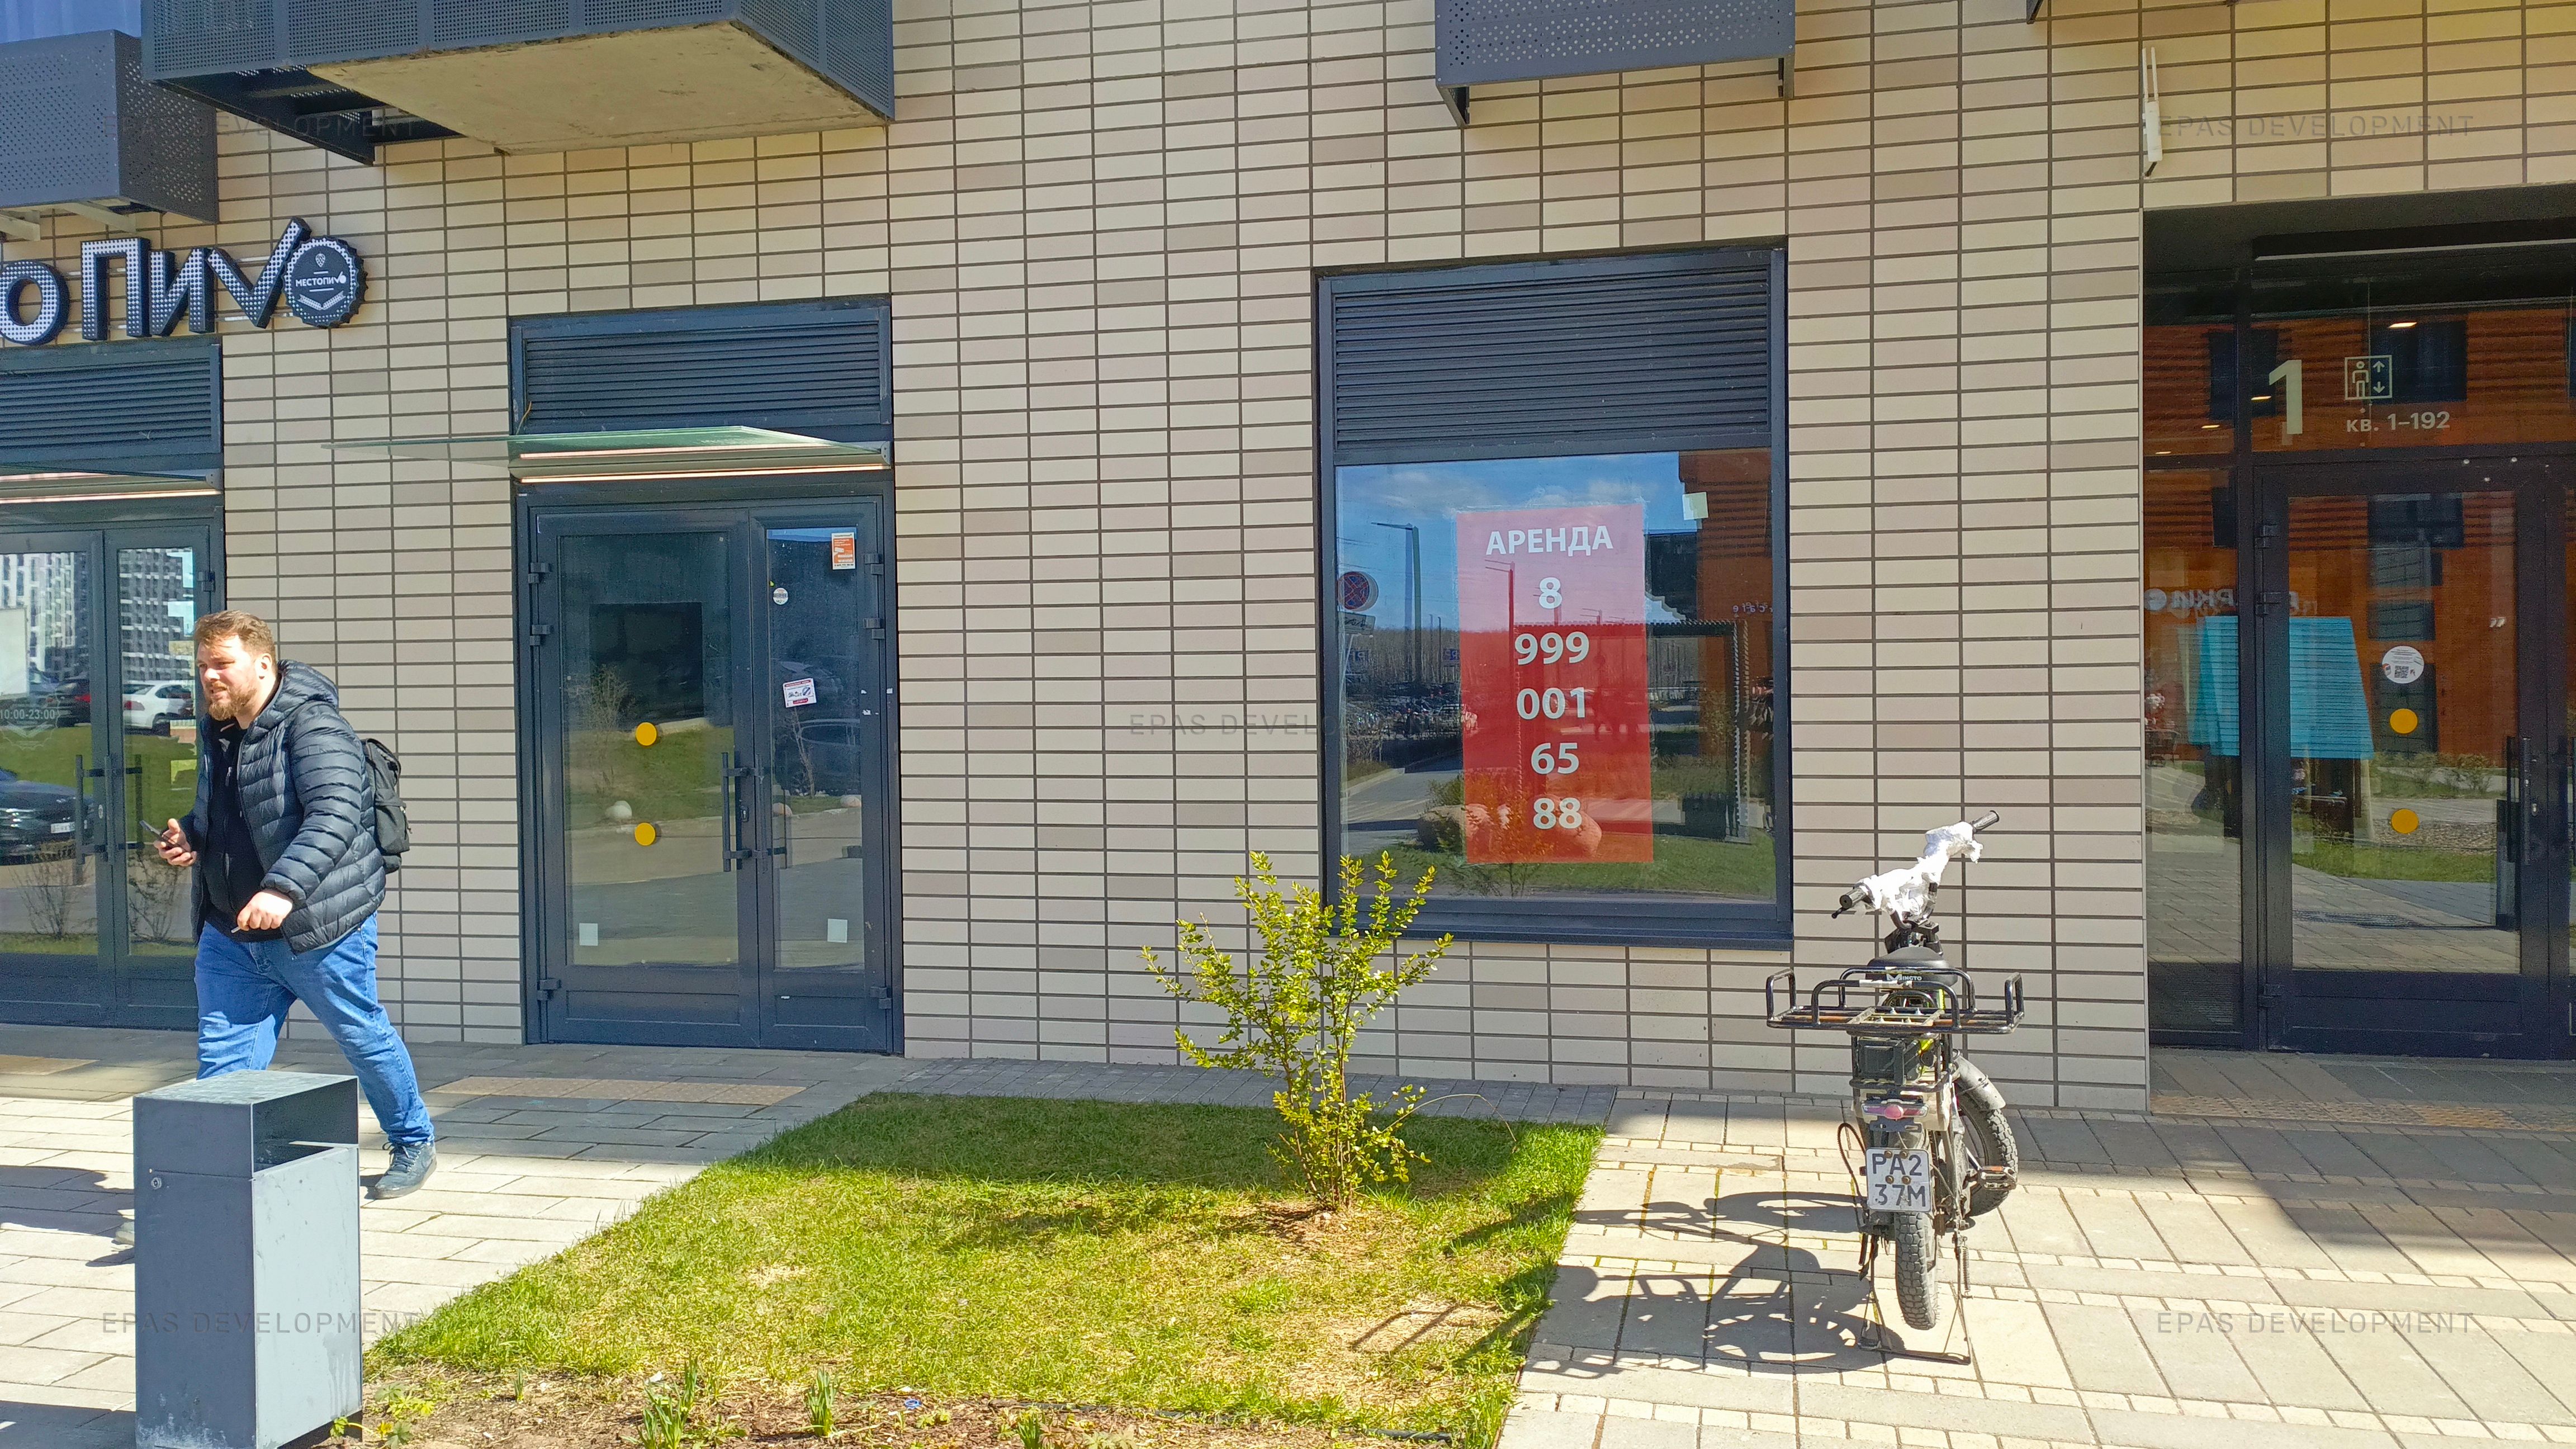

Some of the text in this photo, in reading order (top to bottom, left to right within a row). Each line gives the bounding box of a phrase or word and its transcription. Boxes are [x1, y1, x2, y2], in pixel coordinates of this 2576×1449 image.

[2269, 359, 2303, 434] 1
[1485, 525, 1614, 557] АРЕНДА
[1538, 577, 1563, 609] 8
[1514, 631, 1589, 665] 999
[1517, 687, 1585, 719] 001
[1531, 742, 1579, 774] 65
[1533, 797, 1582, 830] 88
